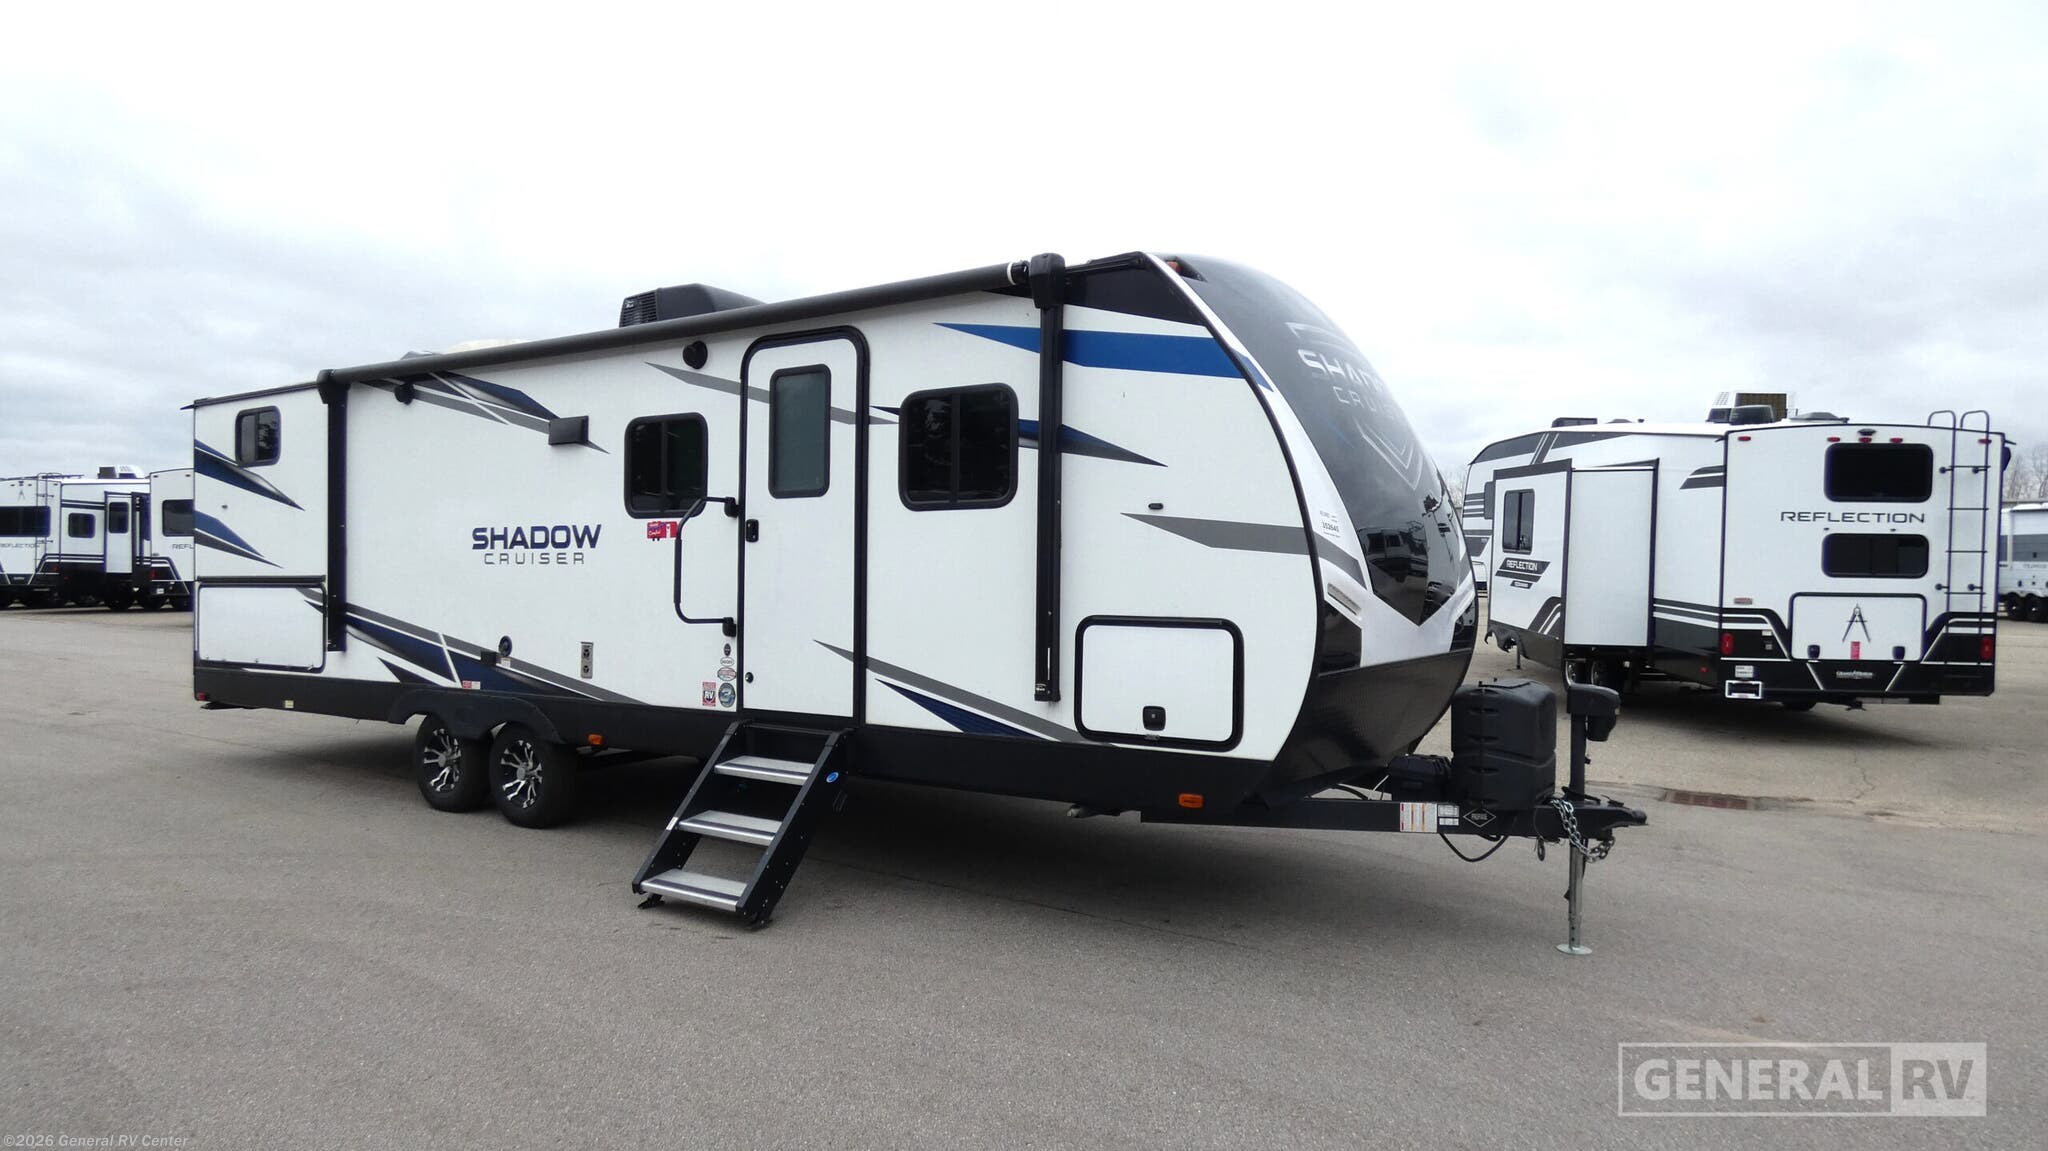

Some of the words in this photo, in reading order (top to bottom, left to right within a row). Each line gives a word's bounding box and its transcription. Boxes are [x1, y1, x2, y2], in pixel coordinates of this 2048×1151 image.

[1297, 349, 1384, 393] SHAD
[1780, 511, 1925, 523] REFLECTION
[472, 524, 602, 549] SHADOW
[484, 552, 585, 565] CRUISER
[1506, 560, 1538, 571] REFLECTION
